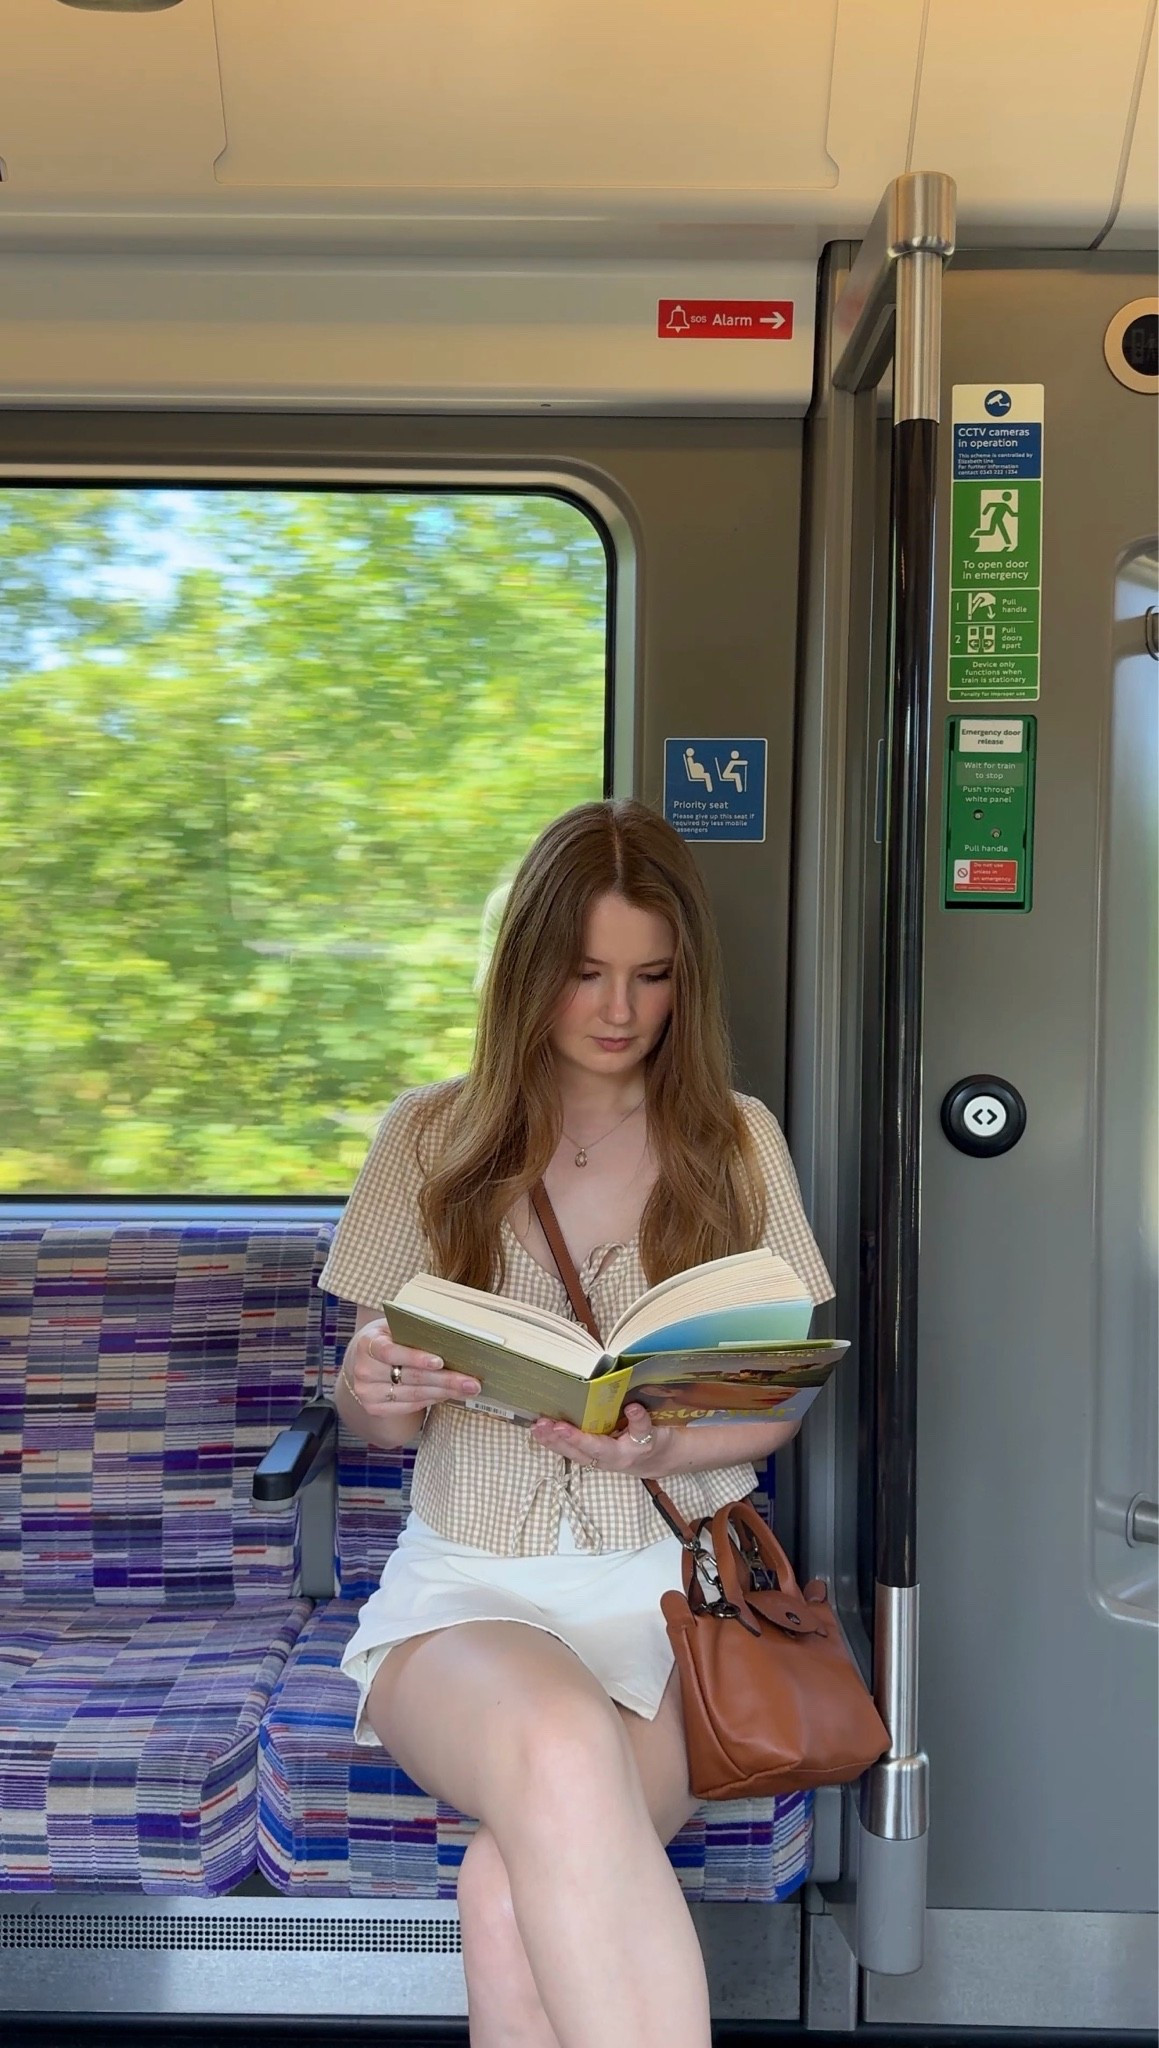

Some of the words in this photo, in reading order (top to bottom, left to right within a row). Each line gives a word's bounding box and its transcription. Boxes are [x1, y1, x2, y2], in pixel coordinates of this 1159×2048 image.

[712, 314, 752, 326] Alarm
[958, 428, 986, 436] CCTV
[959, 439, 967, 447] in
[970, 439, 1018, 449] operation
[963, 560, 974, 568] To
[978, 561, 1002, 570] open
[1006, 560, 1028, 568] door
[963, 571, 971, 579] in
[975, 572, 1028, 580] emergency
[955, 635, 960, 643] 2
[984, 786, 1014, 794] through
[674, 801, 706, 810] Priority
